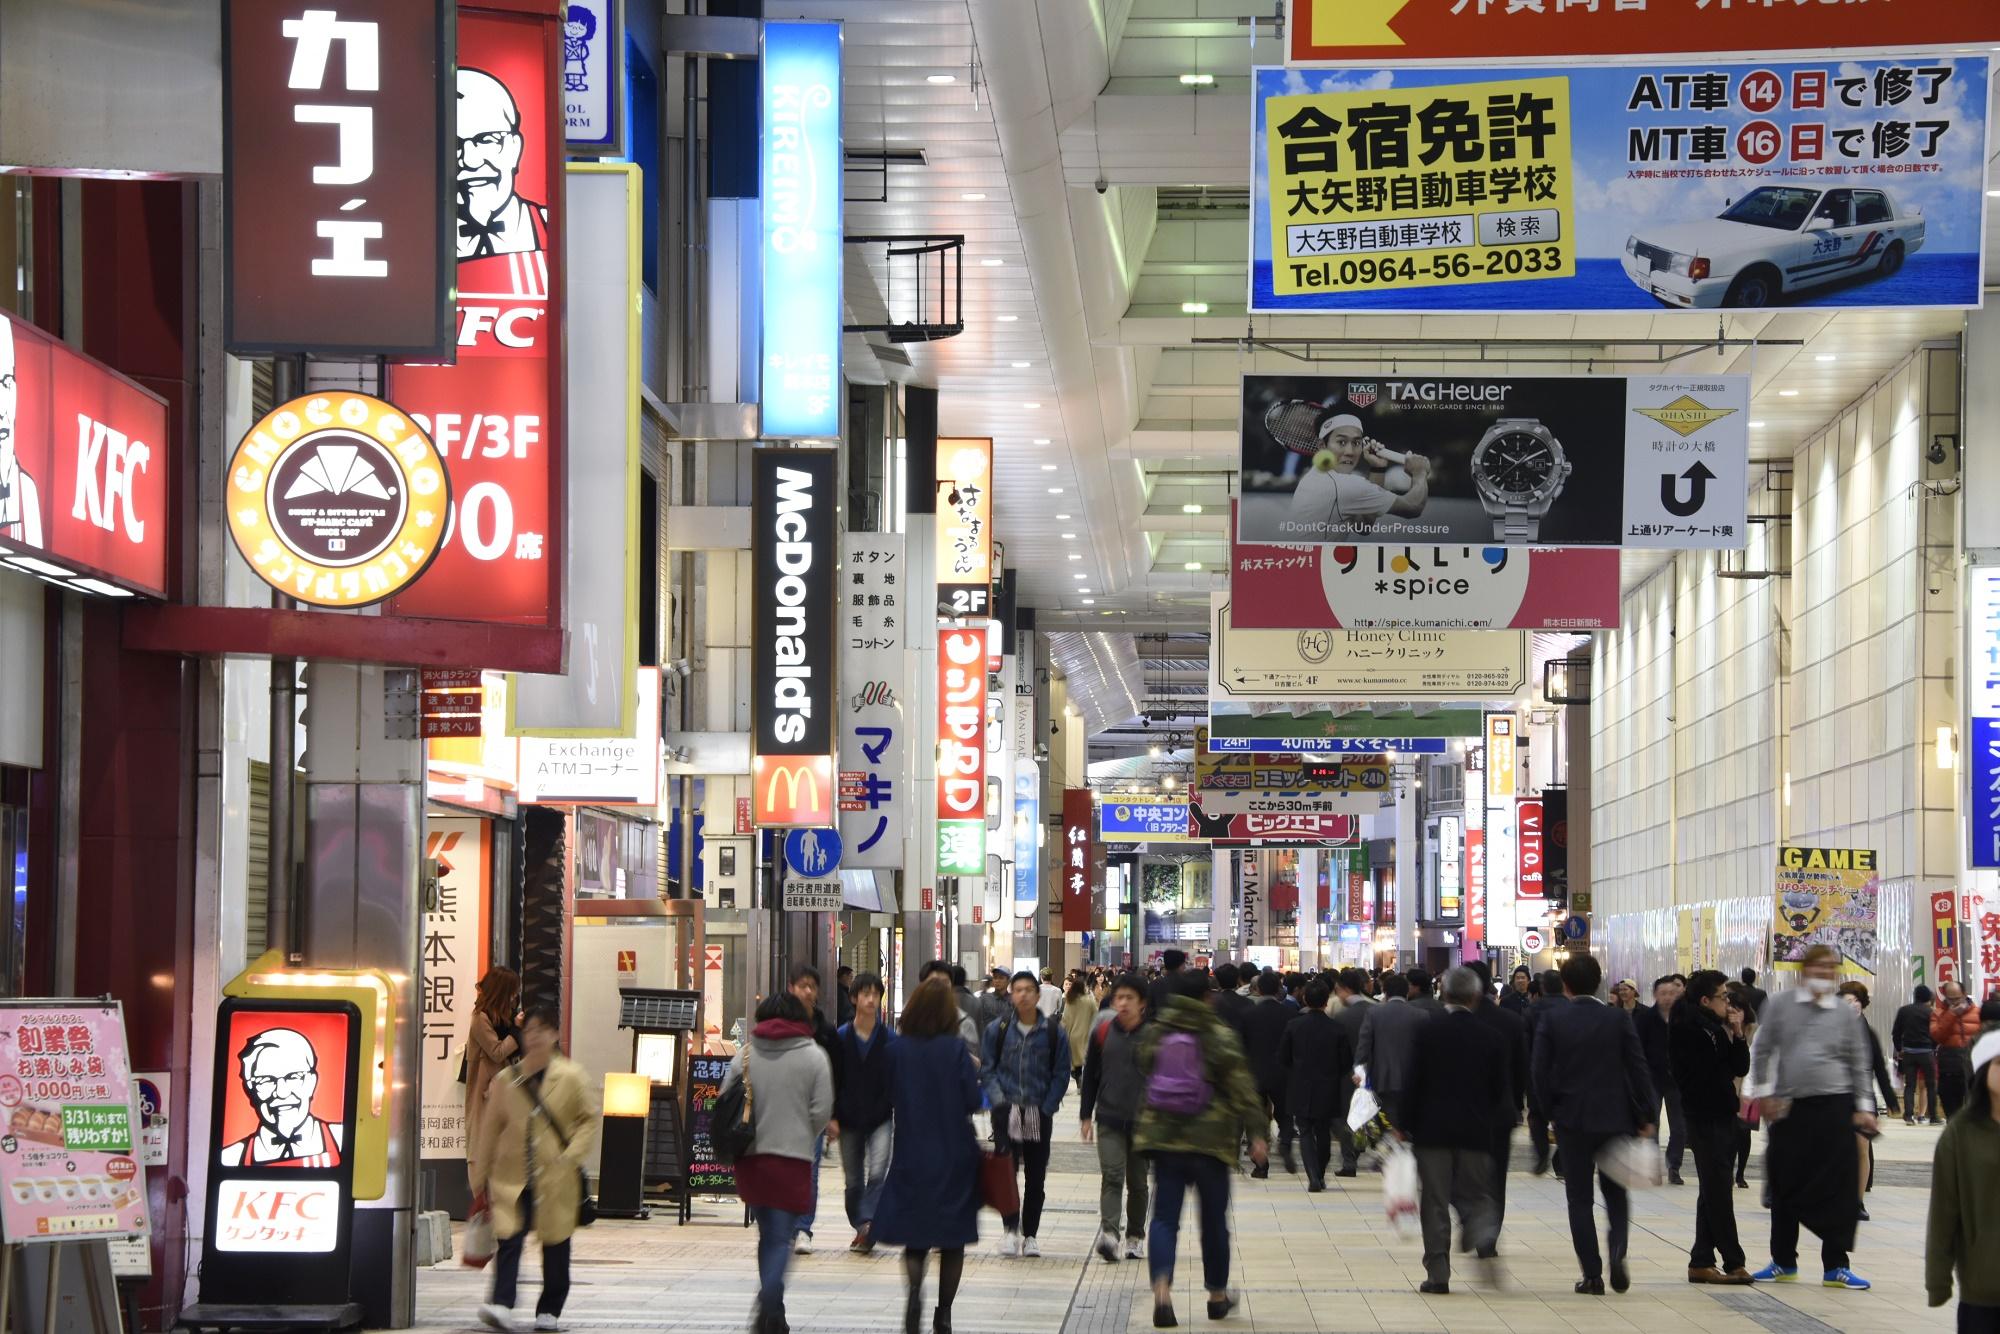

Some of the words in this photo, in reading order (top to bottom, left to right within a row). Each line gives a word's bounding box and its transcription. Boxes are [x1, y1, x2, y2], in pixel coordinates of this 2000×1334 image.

[1276, 93, 1557, 176] 合宿免許
[282, 9, 388, 277] カフェ
[1286, 165, 1558, 217] 大矢野自動車学校
[1295, 220, 1462, 254] 大矢野自動車学校
[1496, 216, 1541, 238] 検索
[1812, 237, 1842, 256] 大矢野
[1290, 247, 1562, 289] Tel.0964-56-2033
[457, 306, 540, 349] FC
[1350, 383, 1376, 393] TAG
[1648, 384, 1726, 392] タグホイヤー正規取扱店
[1350, 394, 1376, 407] HEUER
[1660, 411, 1707, 420] OHASHI
[234, 398, 440, 496] CHOCOCRO
[1652, 440, 1716, 453] 時計の大橋
[70, 412, 151, 544] KFC
[1278, 520, 1450, 535] #DontCrackUnderPressure
[1627, 523, 1735, 538] 上通りアーケード奥
[773, 465, 813, 744] McDonald's
[851, 593, 896, 607] 服飾品
[951, 589, 988, 613] 2F
[1354, 617, 1493, 629] http://spice.kumanichi.com/
[1543, 617, 1603, 628] 熊本日日新聞社
[851, 638, 896, 650] コットン
[1346, 630, 1395, 646] Honey
[1347, 647, 1445, 659] ハニークリニック
[1305, 675, 1319, 685] 4F
[427, 695, 474, 705] 送水口
[427, 721, 475, 733] 非常ベル
[1223, 738, 1248, 748] 24H
[549, 742, 635, 762] Exchange
[537, 762, 640, 776] ATMコーナー
[1202, 774, 1251, 788] すぐそこ!
[1361, 772, 1385, 786] 24h
[853, 726, 894, 854] マキノ
[1133, 806, 1188, 822] 中央コン
[1248, 800, 1333, 812] ここから30m手前
[1246, 814, 1333, 832] ビッグエコー
[1067, 825, 1087, 895] 紅蘭亭
[1783, 847, 1871, 870] GAME
[786, 883, 841, 895] 歩行者用道路
[786, 896, 841, 908] 自転車も乗れません
[421, 885, 458, 1060] 熊本銀行
[17, 1025, 93, 1054] 創業祭
[17, 1056, 104, 1077] お楽しみ袋
[66, 1126, 129, 1145] 残りわずか!
[231, 1191, 326, 1221] KFC
